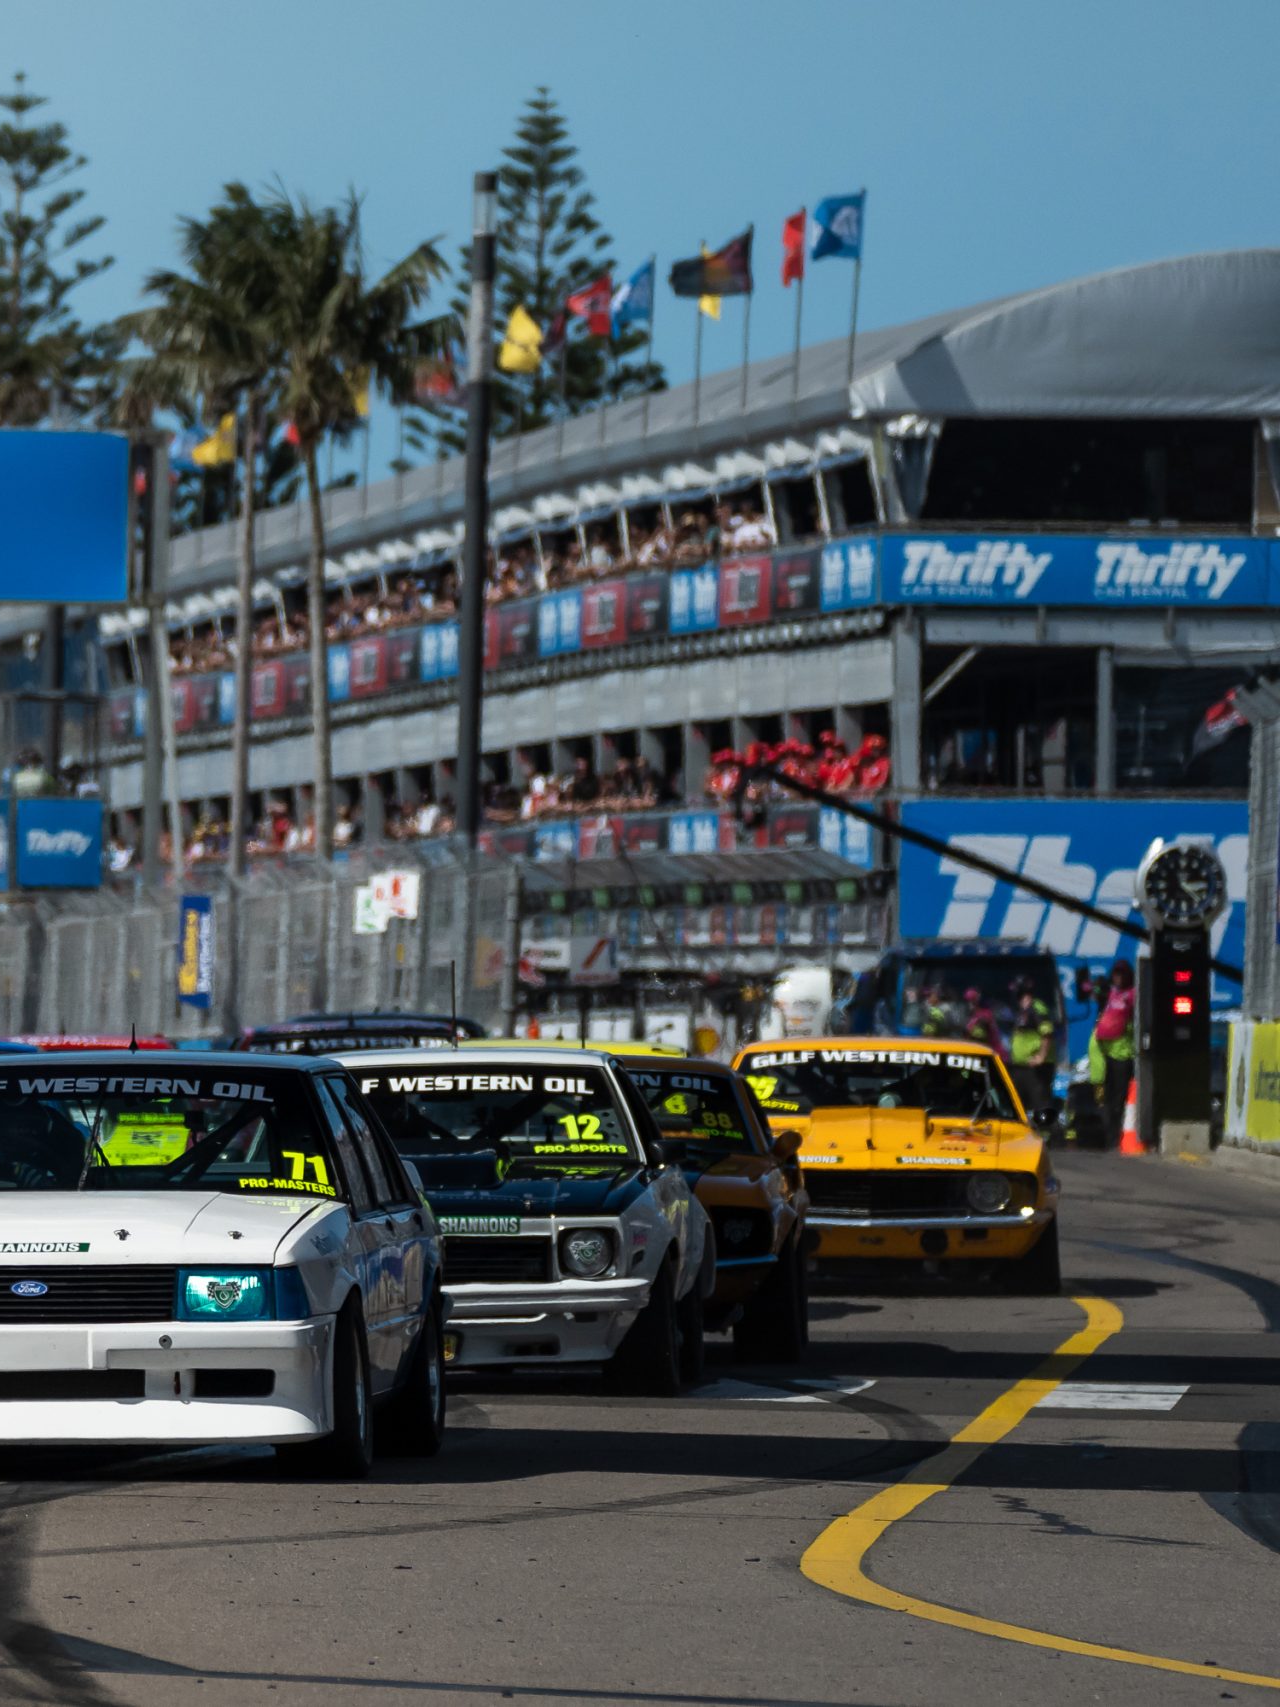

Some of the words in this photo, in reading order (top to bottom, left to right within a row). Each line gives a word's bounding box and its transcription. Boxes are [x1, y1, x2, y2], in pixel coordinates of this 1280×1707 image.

[901, 541, 1053, 598] Thrifty
[1095, 542, 1246, 599] Thrifty
[751, 1050, 815, 1070] GULF
[821, 1049, 940, 1066] WESTERN
[946, 1055, 987, 1073] OIL
[18, 1077, 200, 1097] WESTERN
[212, 1082, 274, 1102] OIL
[388, 1075, 534, 1093] WESTERN
[543, 1077, 594, 1095] OIL
[670, 1075, 719, 1094] OIL
[558, 1114, 604, 1141] 12
[534, 1142, 629, 1155] PRO-SPORTS
[281, 1151, 329, 1185] 71
[238, 1178, 336, 1197] PRO-MASTERS
[438, 1217, 518, 1233] SHANNONS
[17, 1282, 42, 1295] Ford
